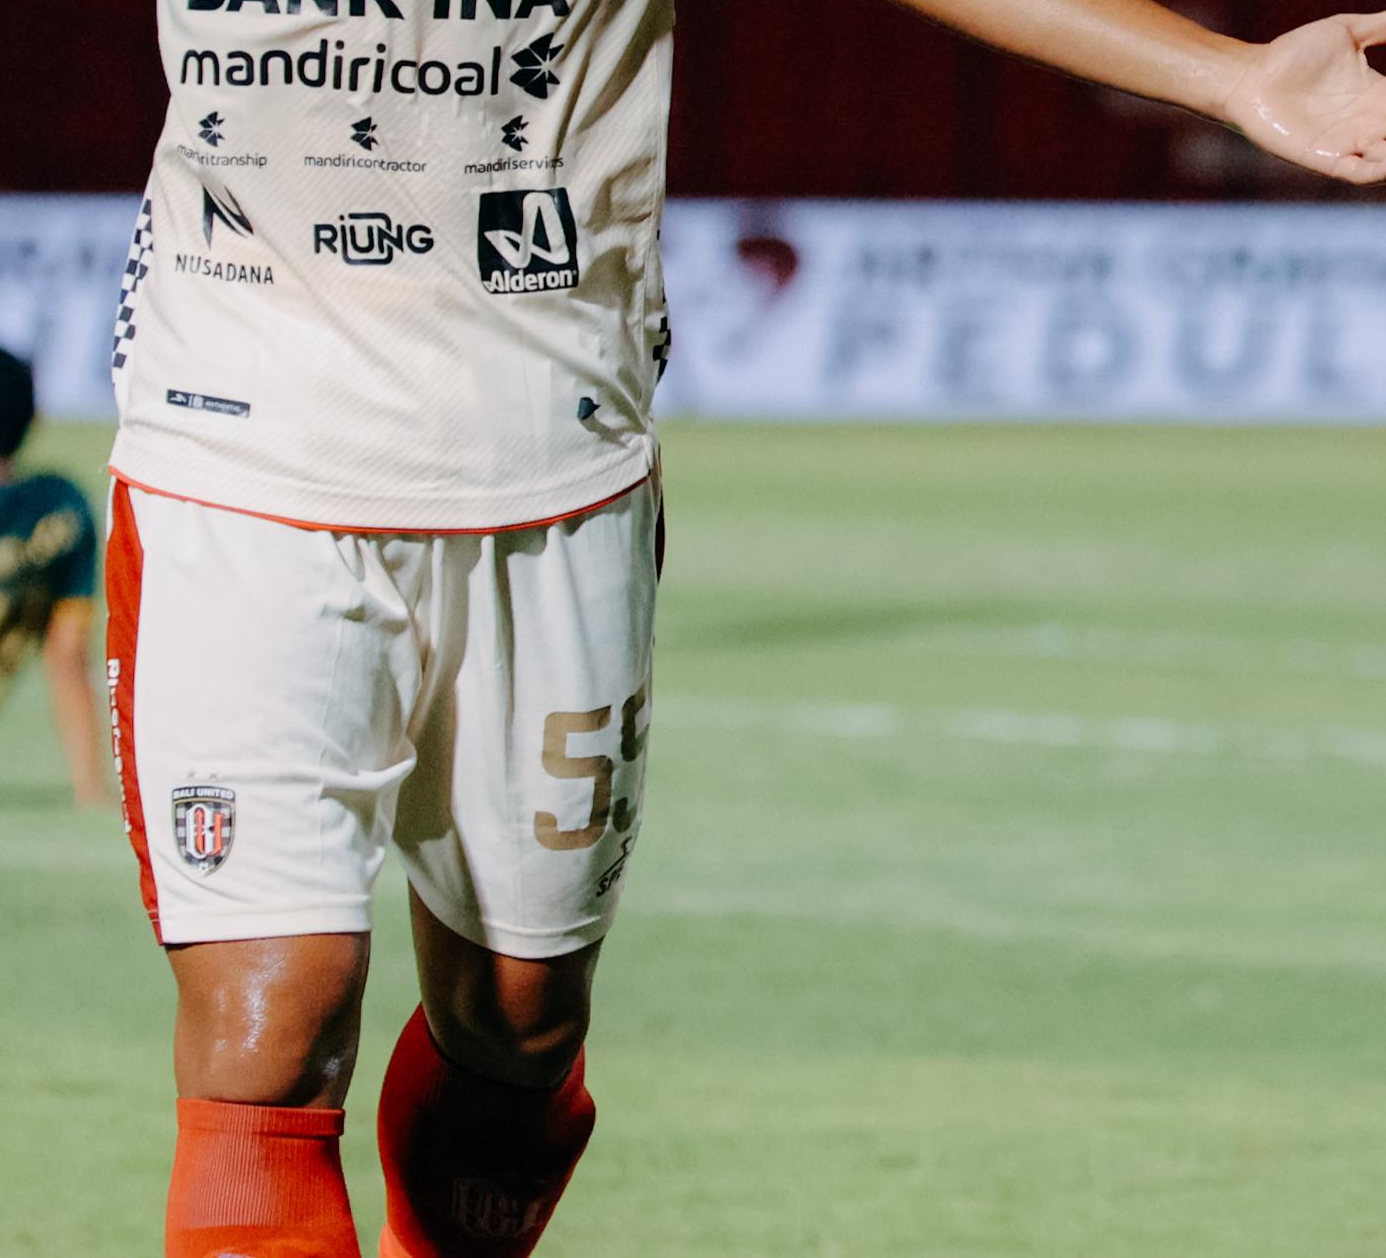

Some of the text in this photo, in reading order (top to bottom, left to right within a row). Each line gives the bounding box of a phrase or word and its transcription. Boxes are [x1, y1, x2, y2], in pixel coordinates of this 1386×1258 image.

[180, 39, 501, 96] mandiricoal
[174, 253, 275, 286] NUSADANA
[482, 269, 574, 292] Alderon
[172, 787, 234, 800] BALI UNITED
